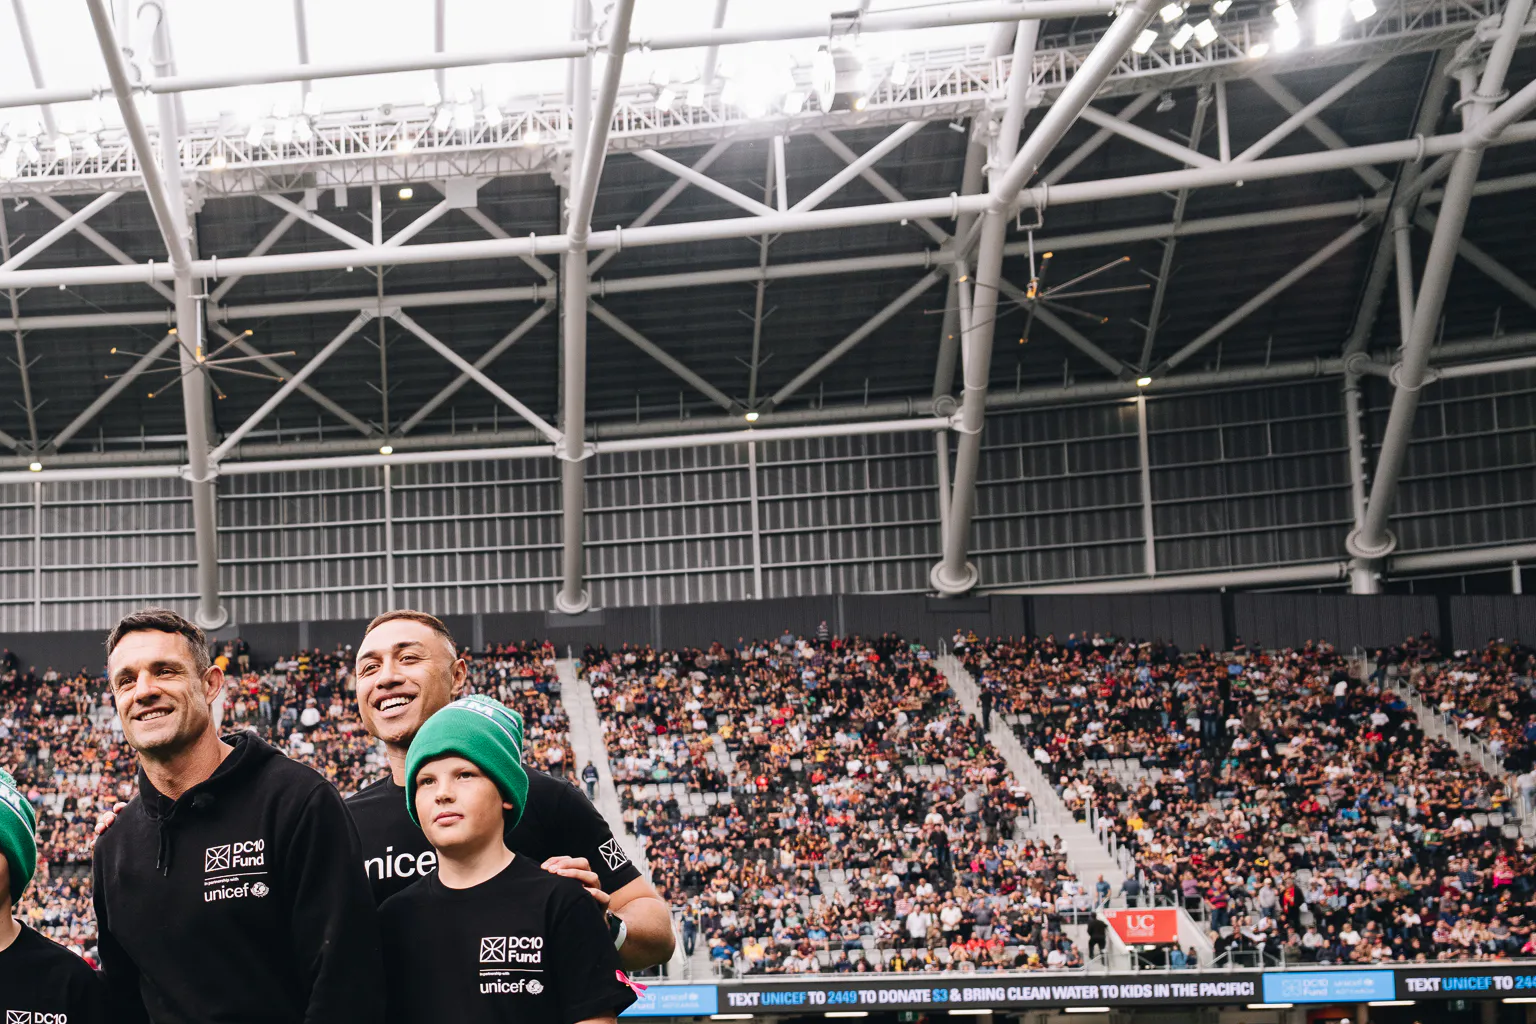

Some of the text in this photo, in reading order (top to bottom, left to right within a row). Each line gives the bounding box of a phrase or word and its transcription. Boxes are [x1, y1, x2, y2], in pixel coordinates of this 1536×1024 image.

[233, 838, 264, 854] DC10
[232, 852, 264, 868] Fund
[365, 846, 436, 880] nice
[204, 882, 249, 902] unicef
[1126, 914, 1155, 930] UC
[508, 936, 544, 949] DC10
[508, 950, 541, 963] Fund
[479, 978, 526, 994] unicef
[1405, 978, 1441, 992] TEXT
[1442, 976, 1492, 990] UNICEF
[1493, 976, 1514, 990] TO
[727, 992, 760, 1006] TEXT
[761, 991, 806, 1005] UNICEF
[808, 990, 826, 1004] TO
[827, 990, 857, 1004] 2449
[858, 990, 878, 1003] TO
[879, 989, 931, 1003] DONATE
[949, 988, 962, 1002] &
[962, 987, 1005, 1001] BRING
[1007, 986, 1051, 1001] CLEAN
[1052, 985, 1099, 1000] WATER
[1100, 985, 1119, 998] TO
[1120, 984, 1152, 998] KIDS
[1154, 984, 1169, 997] IN
[1171, 983, 1198, 997] THE
[1199, 982, 1254, 996] PACIFIC!
[34, 1012, 67, 1024] DC10
